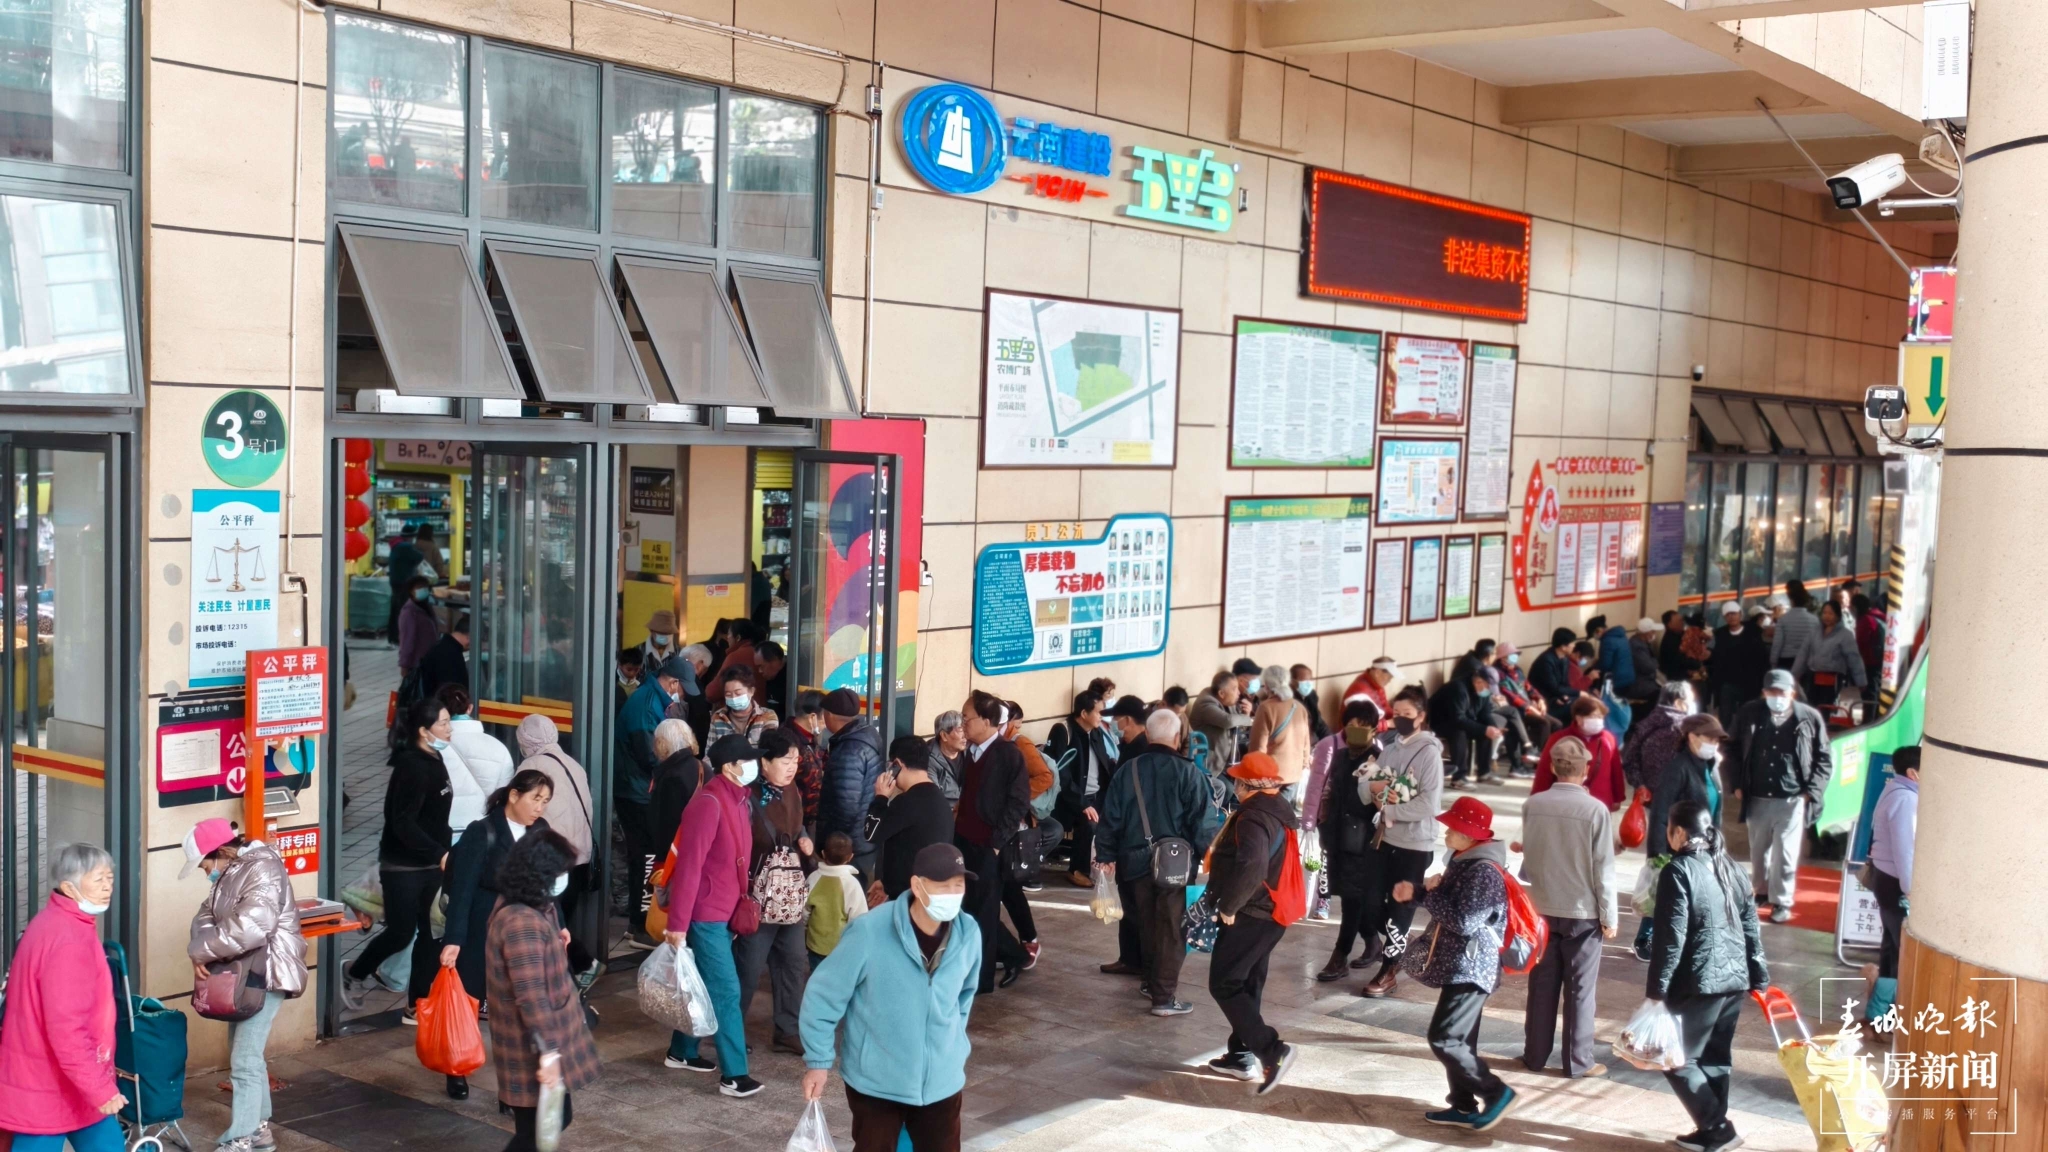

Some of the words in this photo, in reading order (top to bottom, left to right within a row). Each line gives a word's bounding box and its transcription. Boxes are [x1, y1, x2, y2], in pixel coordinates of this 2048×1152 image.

[1011, 117, 1111, 176] 云南建投
[1125, 145, 1234, 232] 五里多
[997, 364, 1031, 377] 农博广场
[216, 410, 244, 459] 3
[247, 438, 277, 456] 号门
[220, 514, 255, 527] 公平秤
[1025, 522, 1084, 541] 员工公示
[1024, 550, 1076, 573] 厚德载物
[1055, 571, 1105, 594] 不忘初心
[198, 600, 232, 613] 关注民生
[237, 598, 271, 611] 计量惠民
[263, 653, 318, 674] 公平秤
[864, 680, 904, 693] etrce
[276, 832, 317, 850] 秤专用
[1855, 913, 1876, 923] 上午
